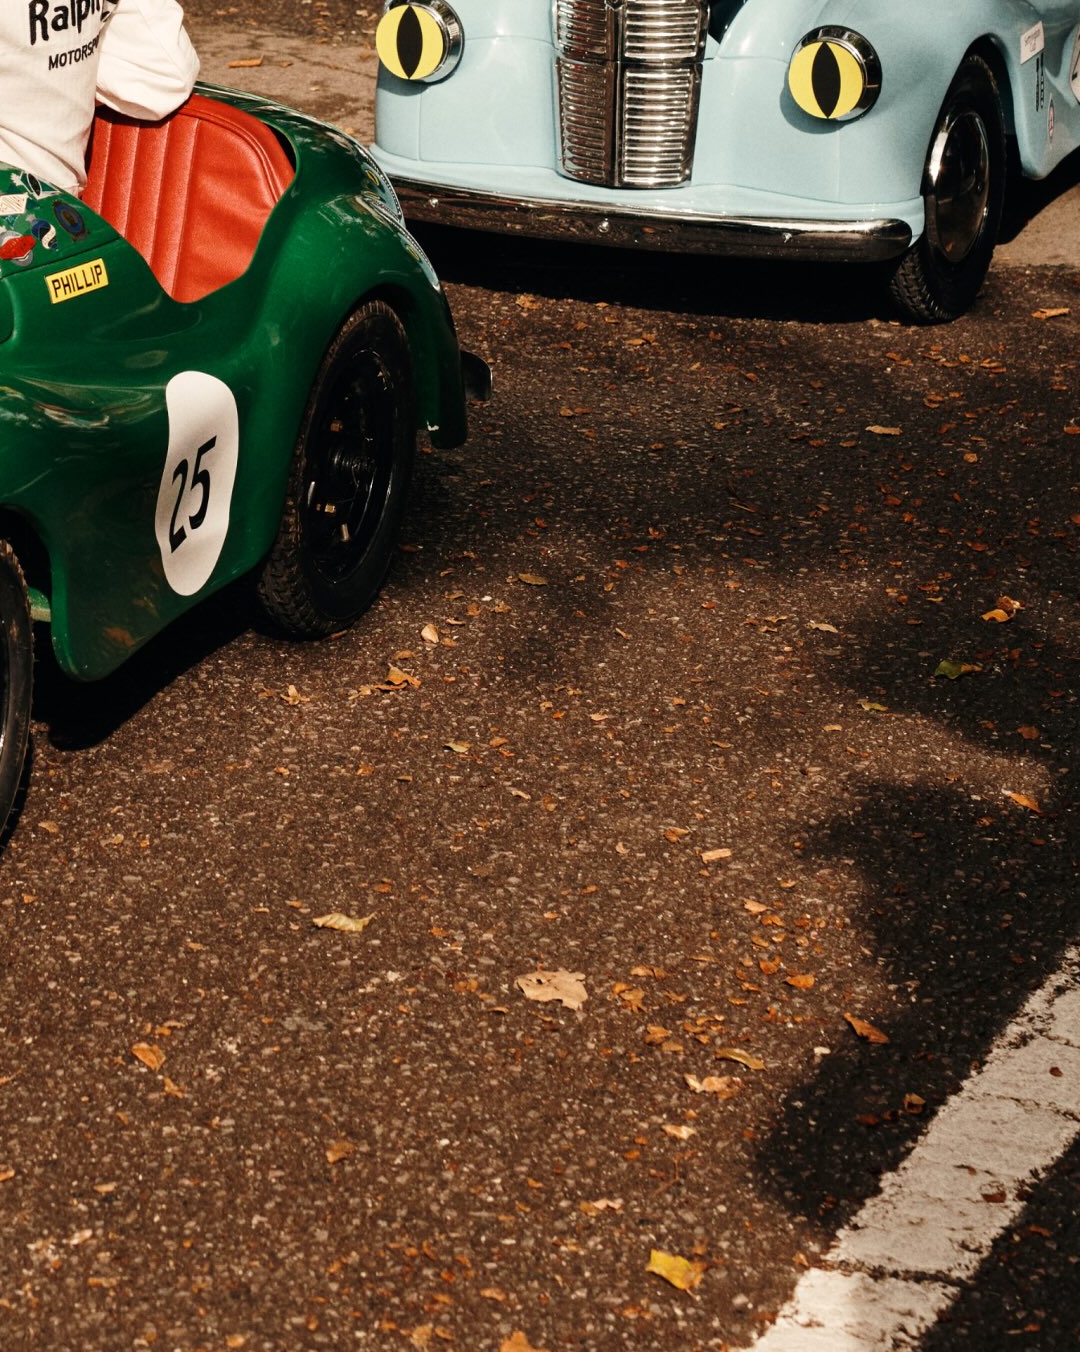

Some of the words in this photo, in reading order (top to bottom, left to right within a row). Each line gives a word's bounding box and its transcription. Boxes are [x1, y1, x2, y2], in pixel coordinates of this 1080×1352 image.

[48, 32, 100, 71] MOTORSP
[51, 264, 103, 298] PHILLIP
[169, 435, 217, 554] 25
